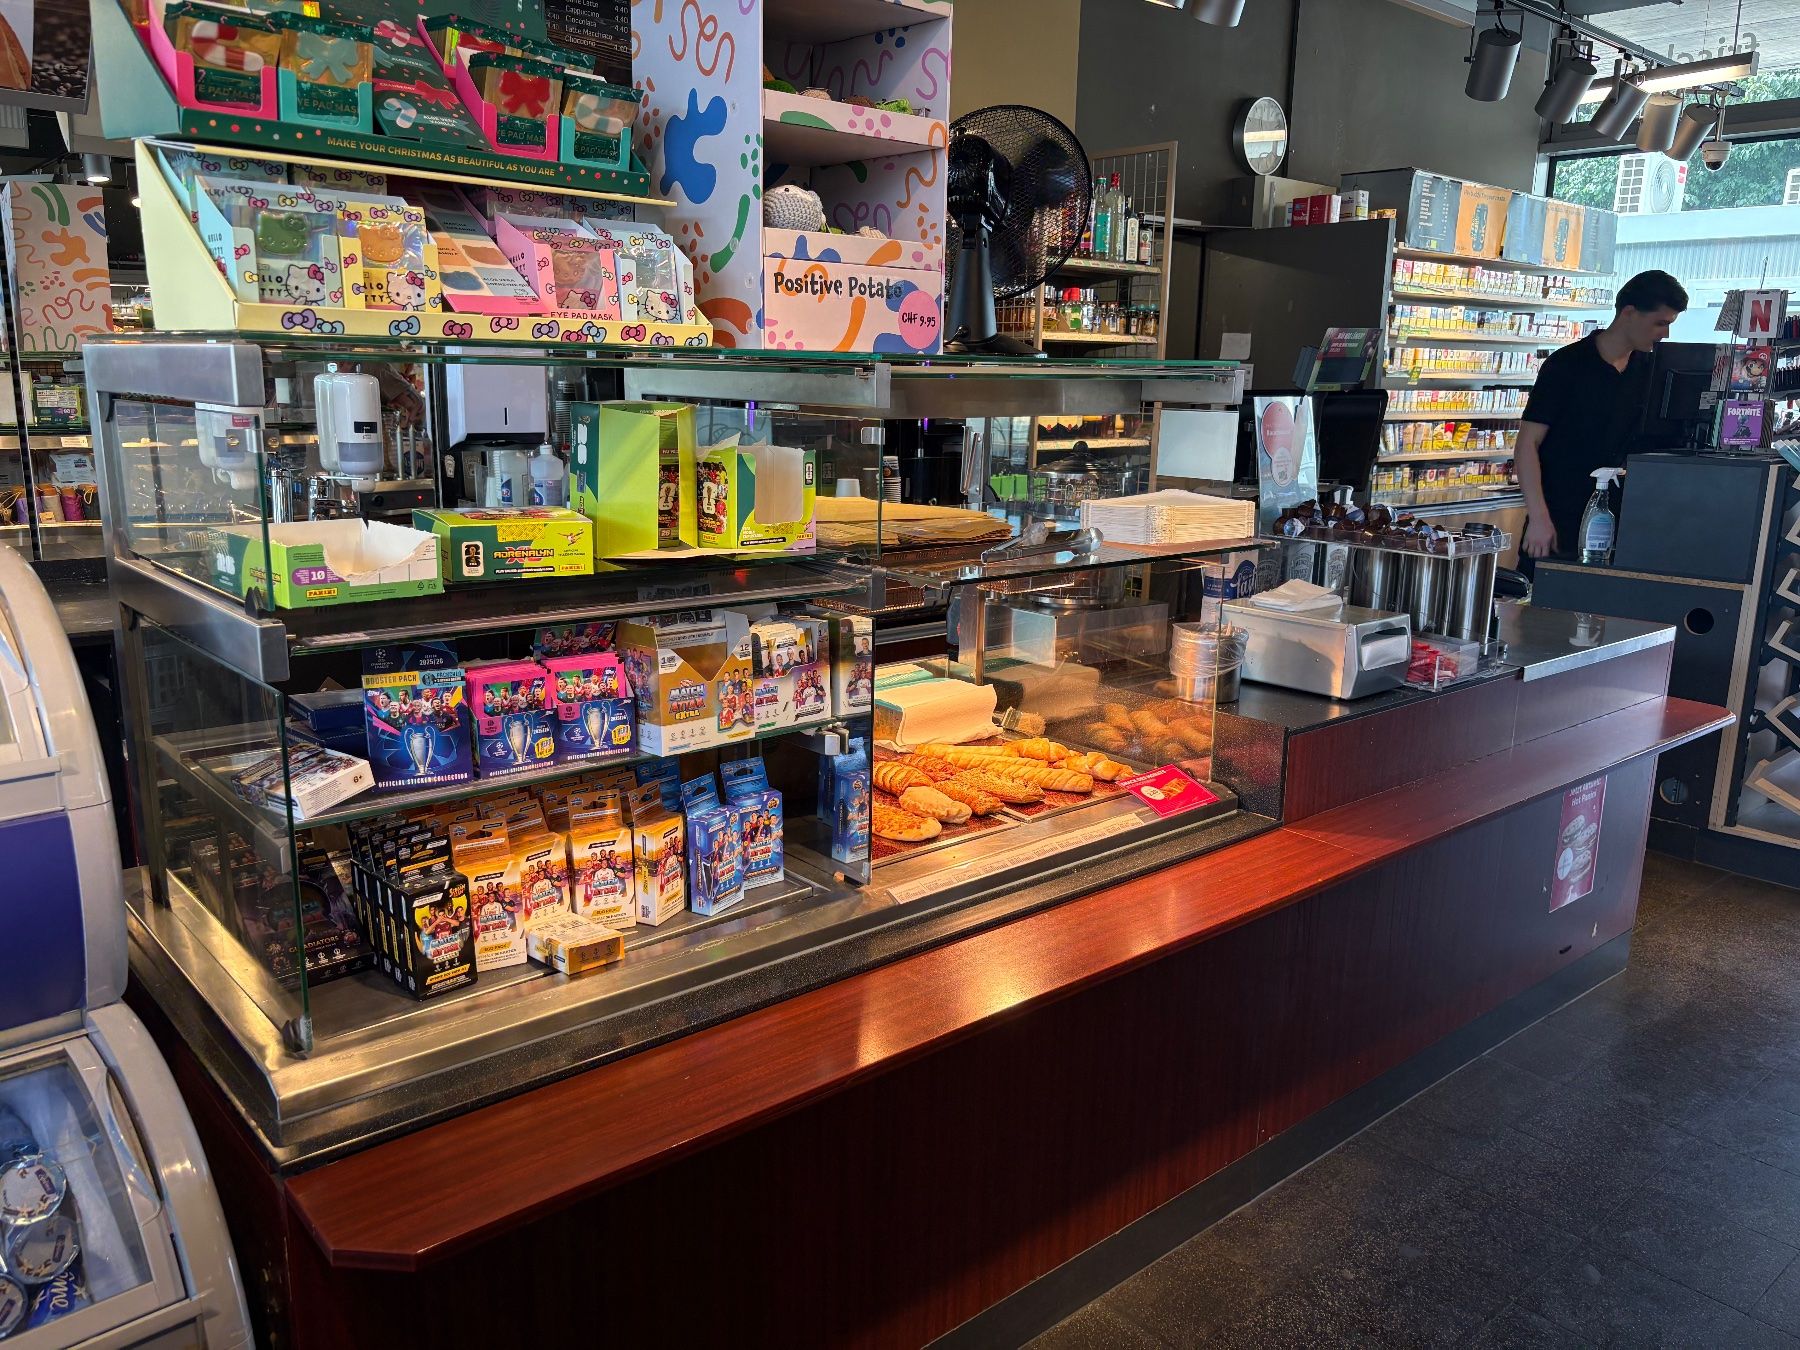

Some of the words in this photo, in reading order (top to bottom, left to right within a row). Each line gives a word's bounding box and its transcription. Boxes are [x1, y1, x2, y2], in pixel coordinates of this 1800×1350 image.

[327, 136, 357, 149] MAKE
[359, 141, 386, 153] YOUR
[387, 145, 442, 161] CHRISTMAS
[443, 154, 456, 164] AS
[457, 156, 505, 171] BEAUTIFUL
[506, 163, 519, 172] AS
[519, 164, 537, 175] YOU
[538, 166, 555, 177] ARE
[773, 271, 843, 295] Positive
[848, 276, 902, 299] Potato
[572, 312, 588, 320] PAD
[591, 313, 614, 321] MASK
[901, 312, 917, 324] CHF
[919, 316, 936, 327] 9.95
[1749, 299, 1773, 332] N
[1727, 407, 1762, 417] FORTNITE
[493, 548, 555, 559] ADRENALYN
[560, 564, 584, 572] PANINI
[311, 570, 325, 581] 10
[307, 588, 337, 597] PANINI
[740, 643, 750, 652] 12
[365, 676, 397, 686] BOOSTER
[398, 674, 417, 683] PACK
[669, 684, 705, 699] MATCH
[353, 774, 363, 783] 6+
